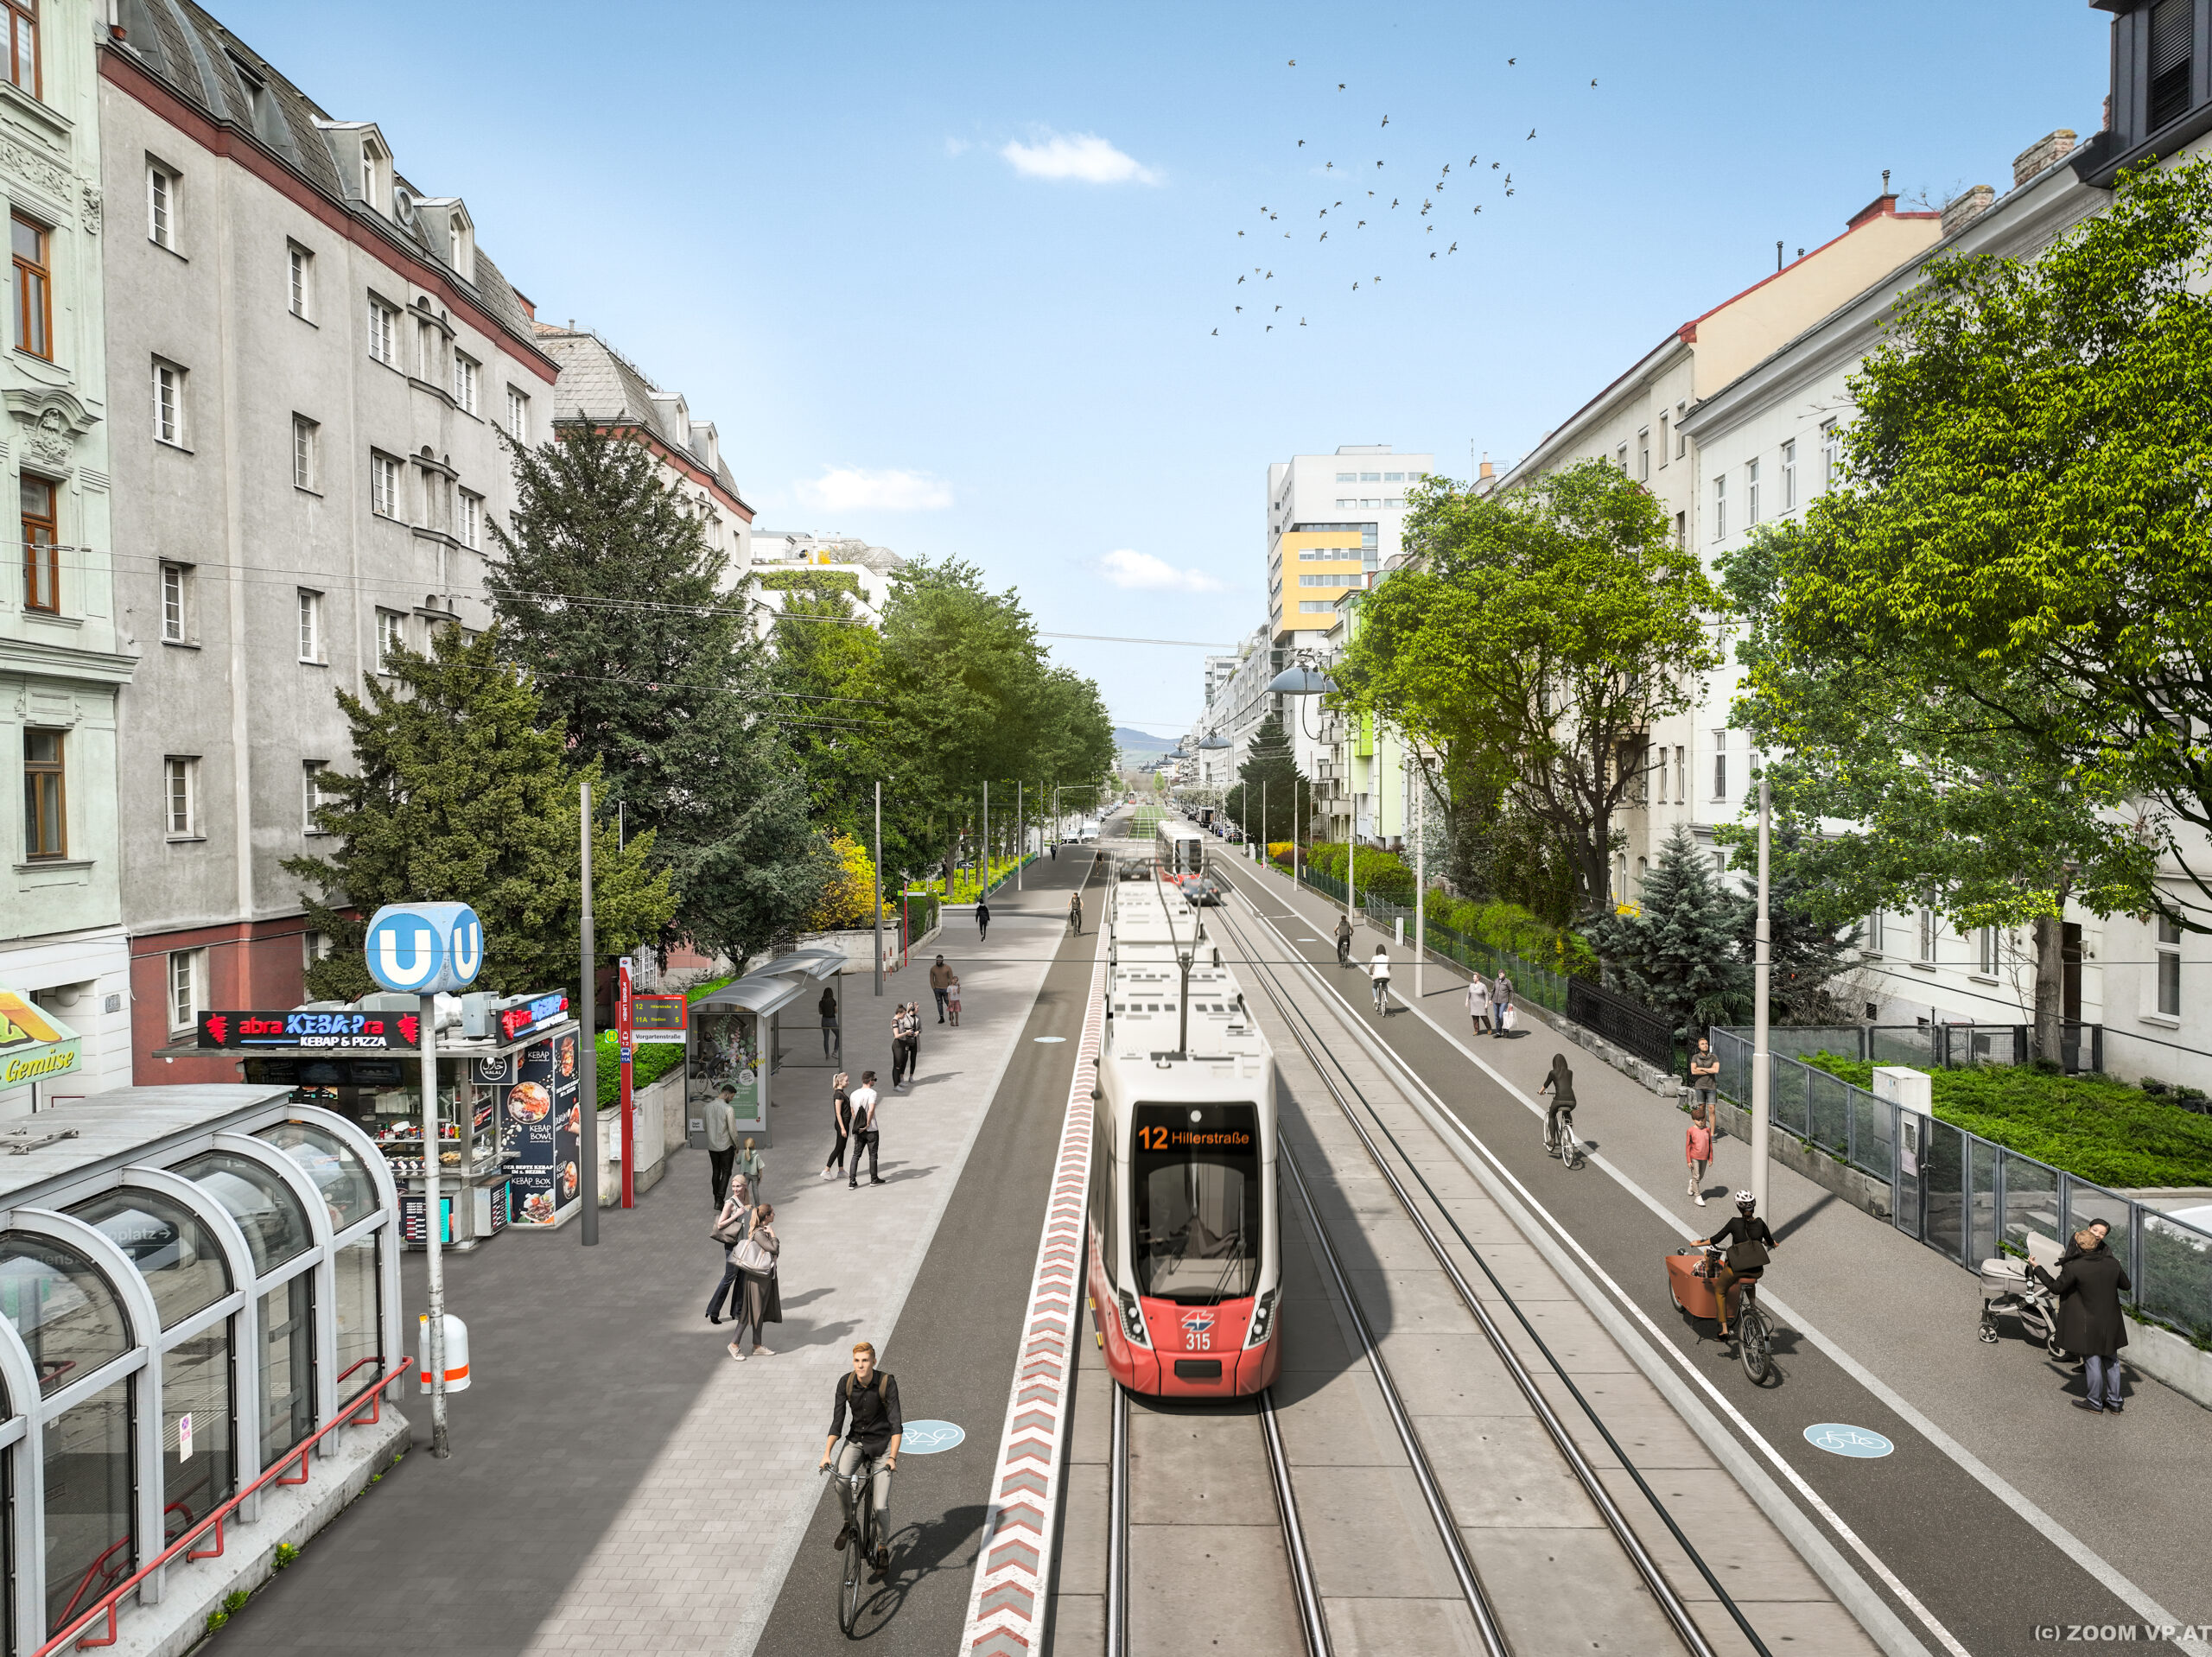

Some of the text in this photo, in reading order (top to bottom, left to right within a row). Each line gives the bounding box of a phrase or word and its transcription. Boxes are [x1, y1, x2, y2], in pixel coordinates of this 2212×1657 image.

[379, 930, 431, 985] U
[454, 922, 478, 980] U
[239, 1017, 283, 1034] abra
[300, 1037, 386, 1046] KEBAP & PIZZA
[528, 1051, 550, 1061] KEBAP
[6, 1048, 73, 1082] Gemüse
[530, 1125, 551, 1133] KEBAP
[1139, 1126, 1249, 1150] 12 Hillerstraße
[105, 1227, 156, 1243] oplatz
[1186, 1334, 1210, 1350] 315
